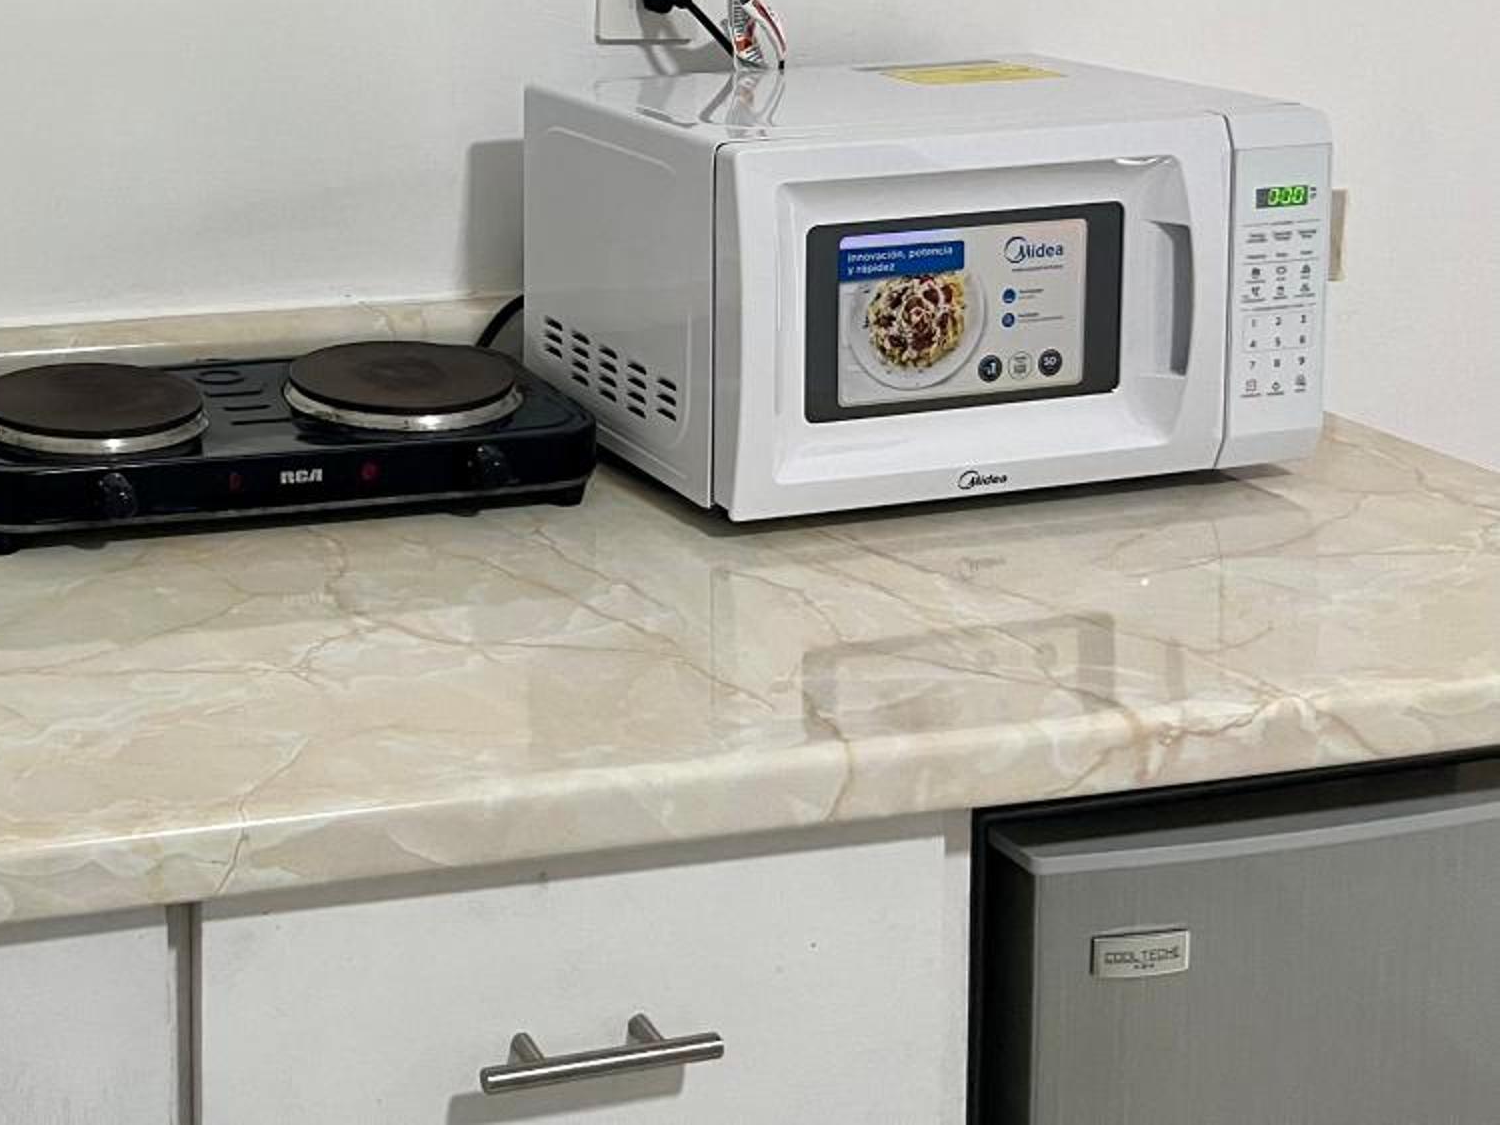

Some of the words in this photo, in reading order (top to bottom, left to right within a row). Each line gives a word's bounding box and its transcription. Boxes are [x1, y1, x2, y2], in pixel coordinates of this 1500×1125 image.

[908, 246, 954, 260] potencia
[1004, 236, 1064, 264] Midea
[847, 266, 855, 276] y
[280, 468, 323, 484] RCA
[957, 470, 1007, 490] Midea
